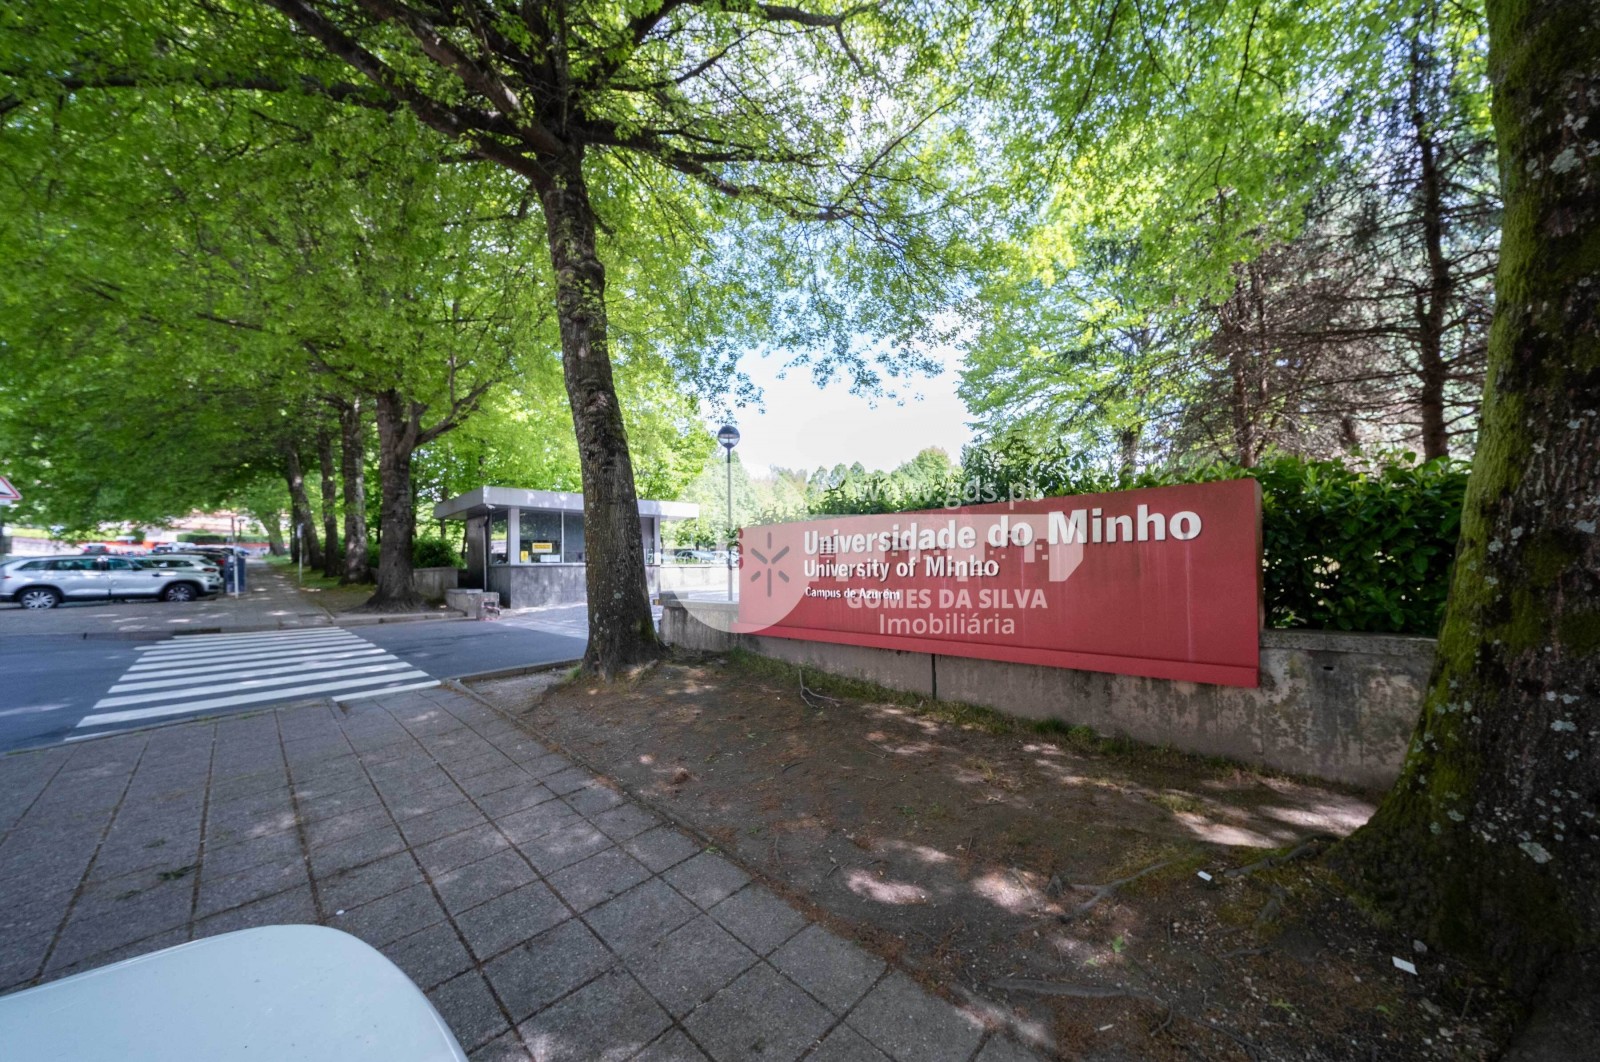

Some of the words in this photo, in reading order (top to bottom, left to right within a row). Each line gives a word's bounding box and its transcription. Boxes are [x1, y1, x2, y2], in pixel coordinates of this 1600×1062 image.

[804, 519, 977, 555] Universidade
[987, 515, 1034, 547] do
[1048, 504, 1202, 545] Minho
[804, 558, 890, 582] University
[896, 557, 917, 577] of
[925, 554, 1000, 577] Minho
[805, 586, 841, 599] Campus
[844, 587, 856, 598] de
[859, 587, 900, 601] Azurém
